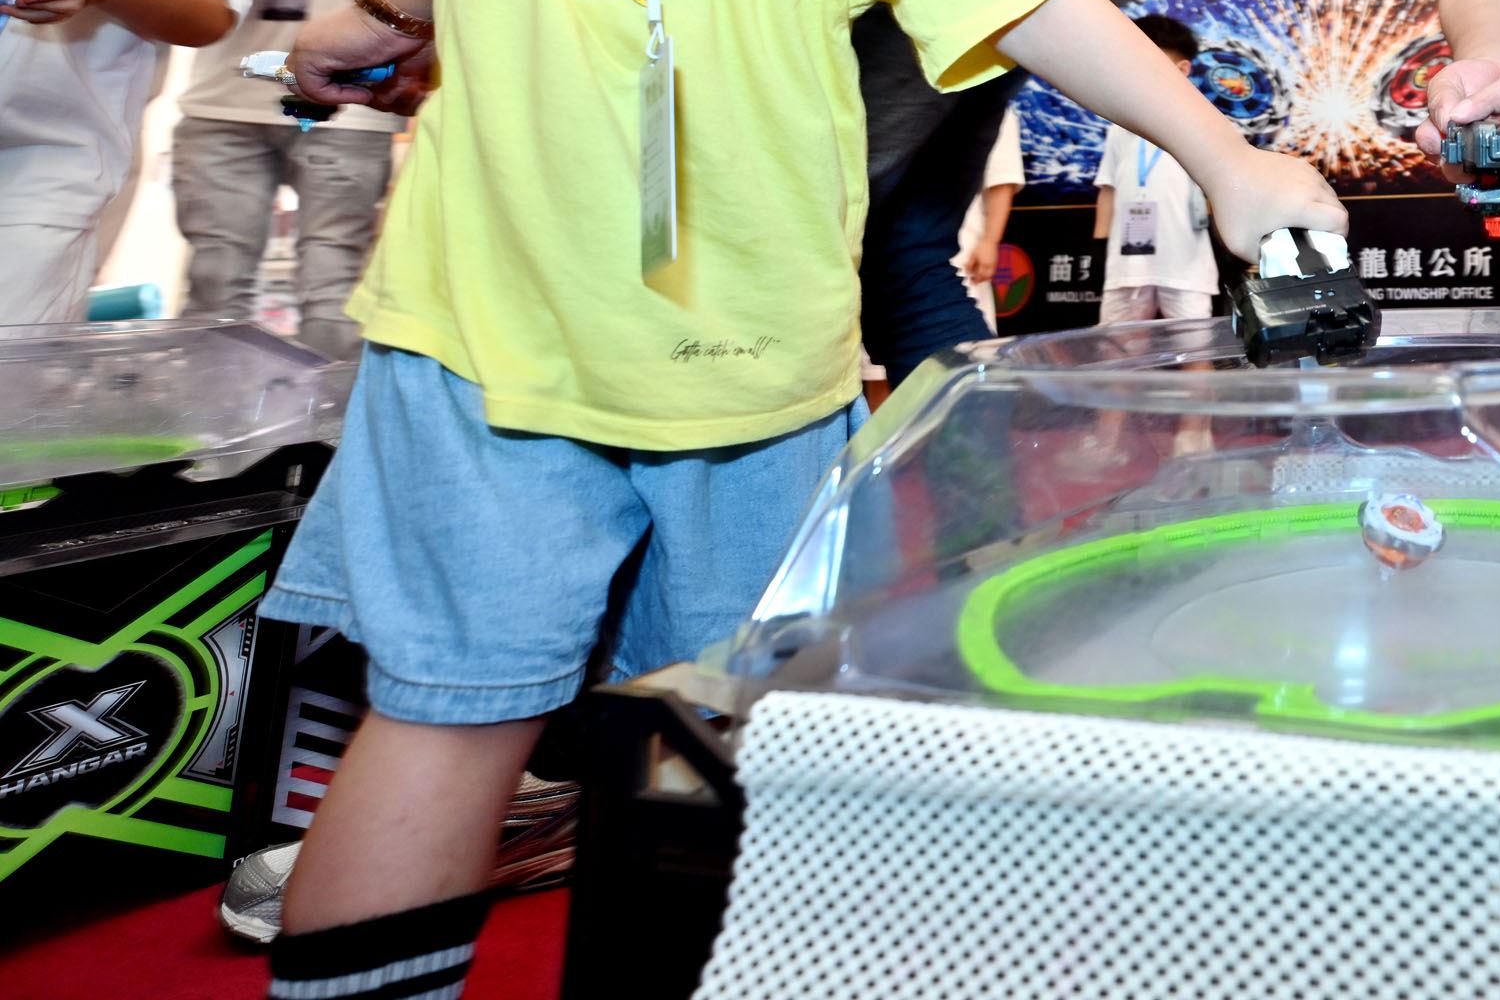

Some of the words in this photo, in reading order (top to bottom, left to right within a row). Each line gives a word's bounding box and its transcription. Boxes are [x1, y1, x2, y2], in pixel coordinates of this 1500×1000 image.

[1359, 247, 1493, 278] 龍鎮公所
[1385, 287, 1450, 300] TOWNSHIP
[1452, 286, 1495, 299] OFFICE
[0, 742, 148, 799] HANGAR
